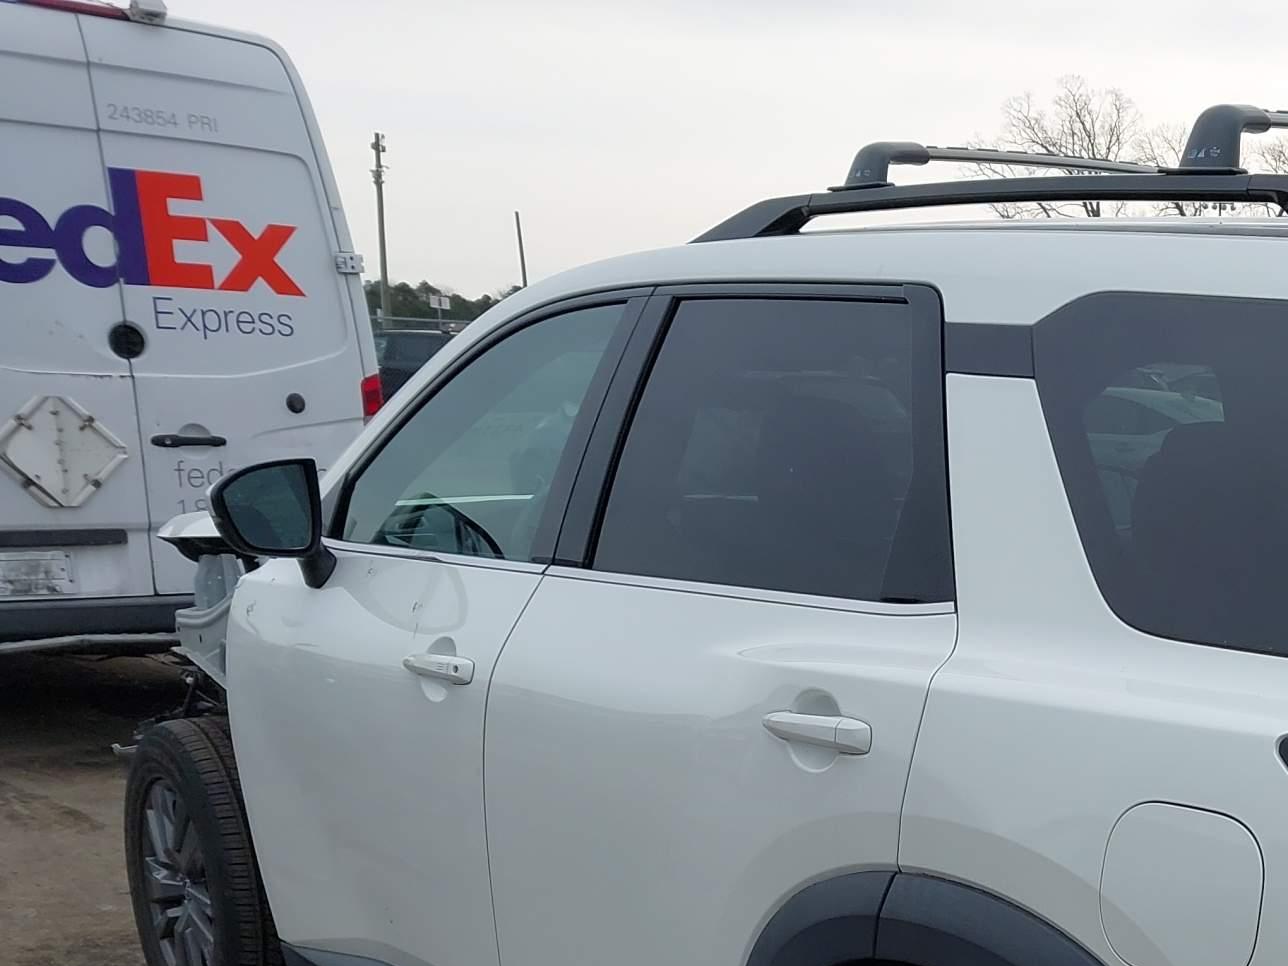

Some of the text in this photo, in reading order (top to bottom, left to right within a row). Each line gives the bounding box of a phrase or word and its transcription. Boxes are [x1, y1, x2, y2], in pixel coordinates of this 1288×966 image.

[106, 103, 219, 132] 243854 PRI
[0, 167, 307, 297] edEx
[152, 296, 295, 340] Express
